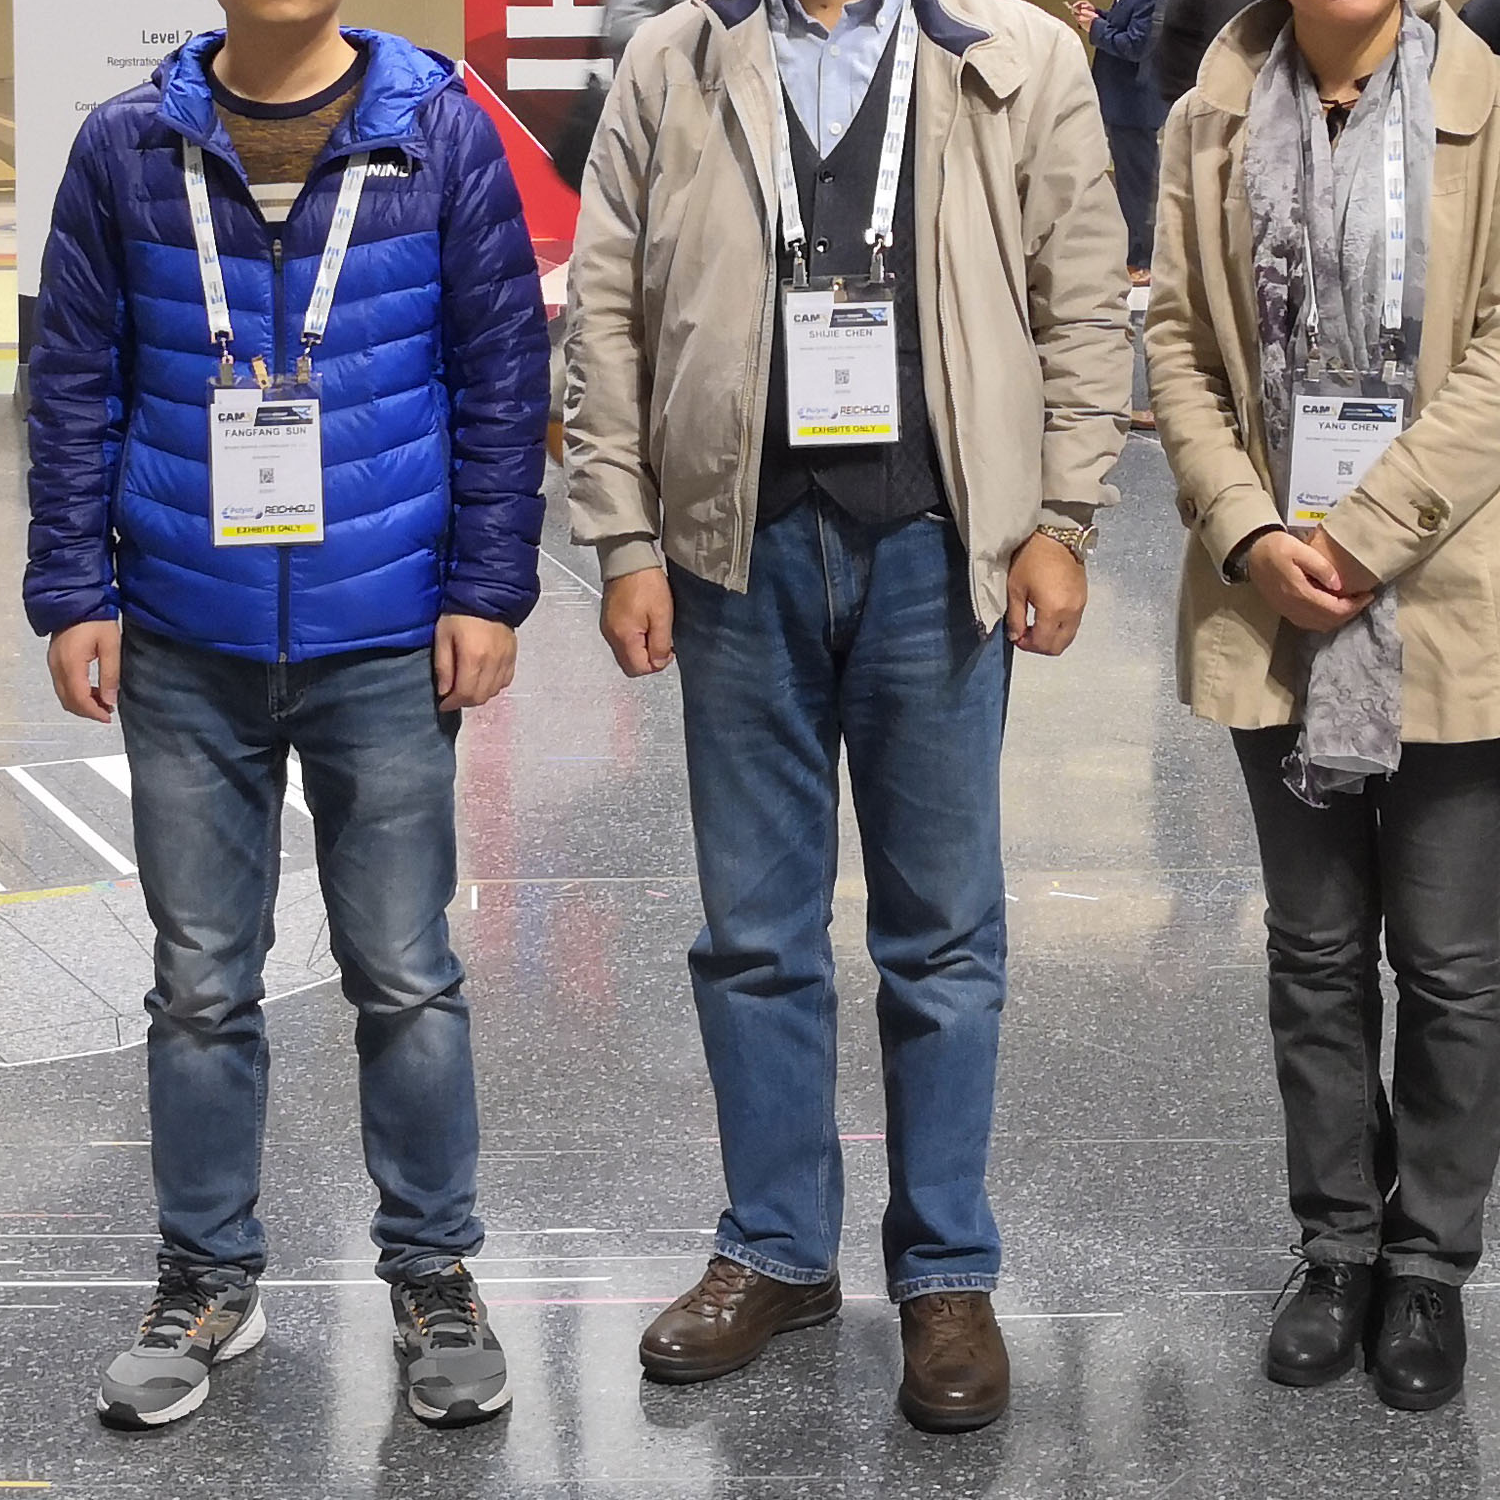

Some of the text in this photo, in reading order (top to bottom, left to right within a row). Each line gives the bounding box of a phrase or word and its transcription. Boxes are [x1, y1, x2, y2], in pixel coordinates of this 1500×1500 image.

[142, 29, 180, 44] Level
[845, 329, 873, 337] CHEN
[1318, 421, 1379, 431] YANG CHEN
[225, 426, 307, 437] FANGFANG SUN
